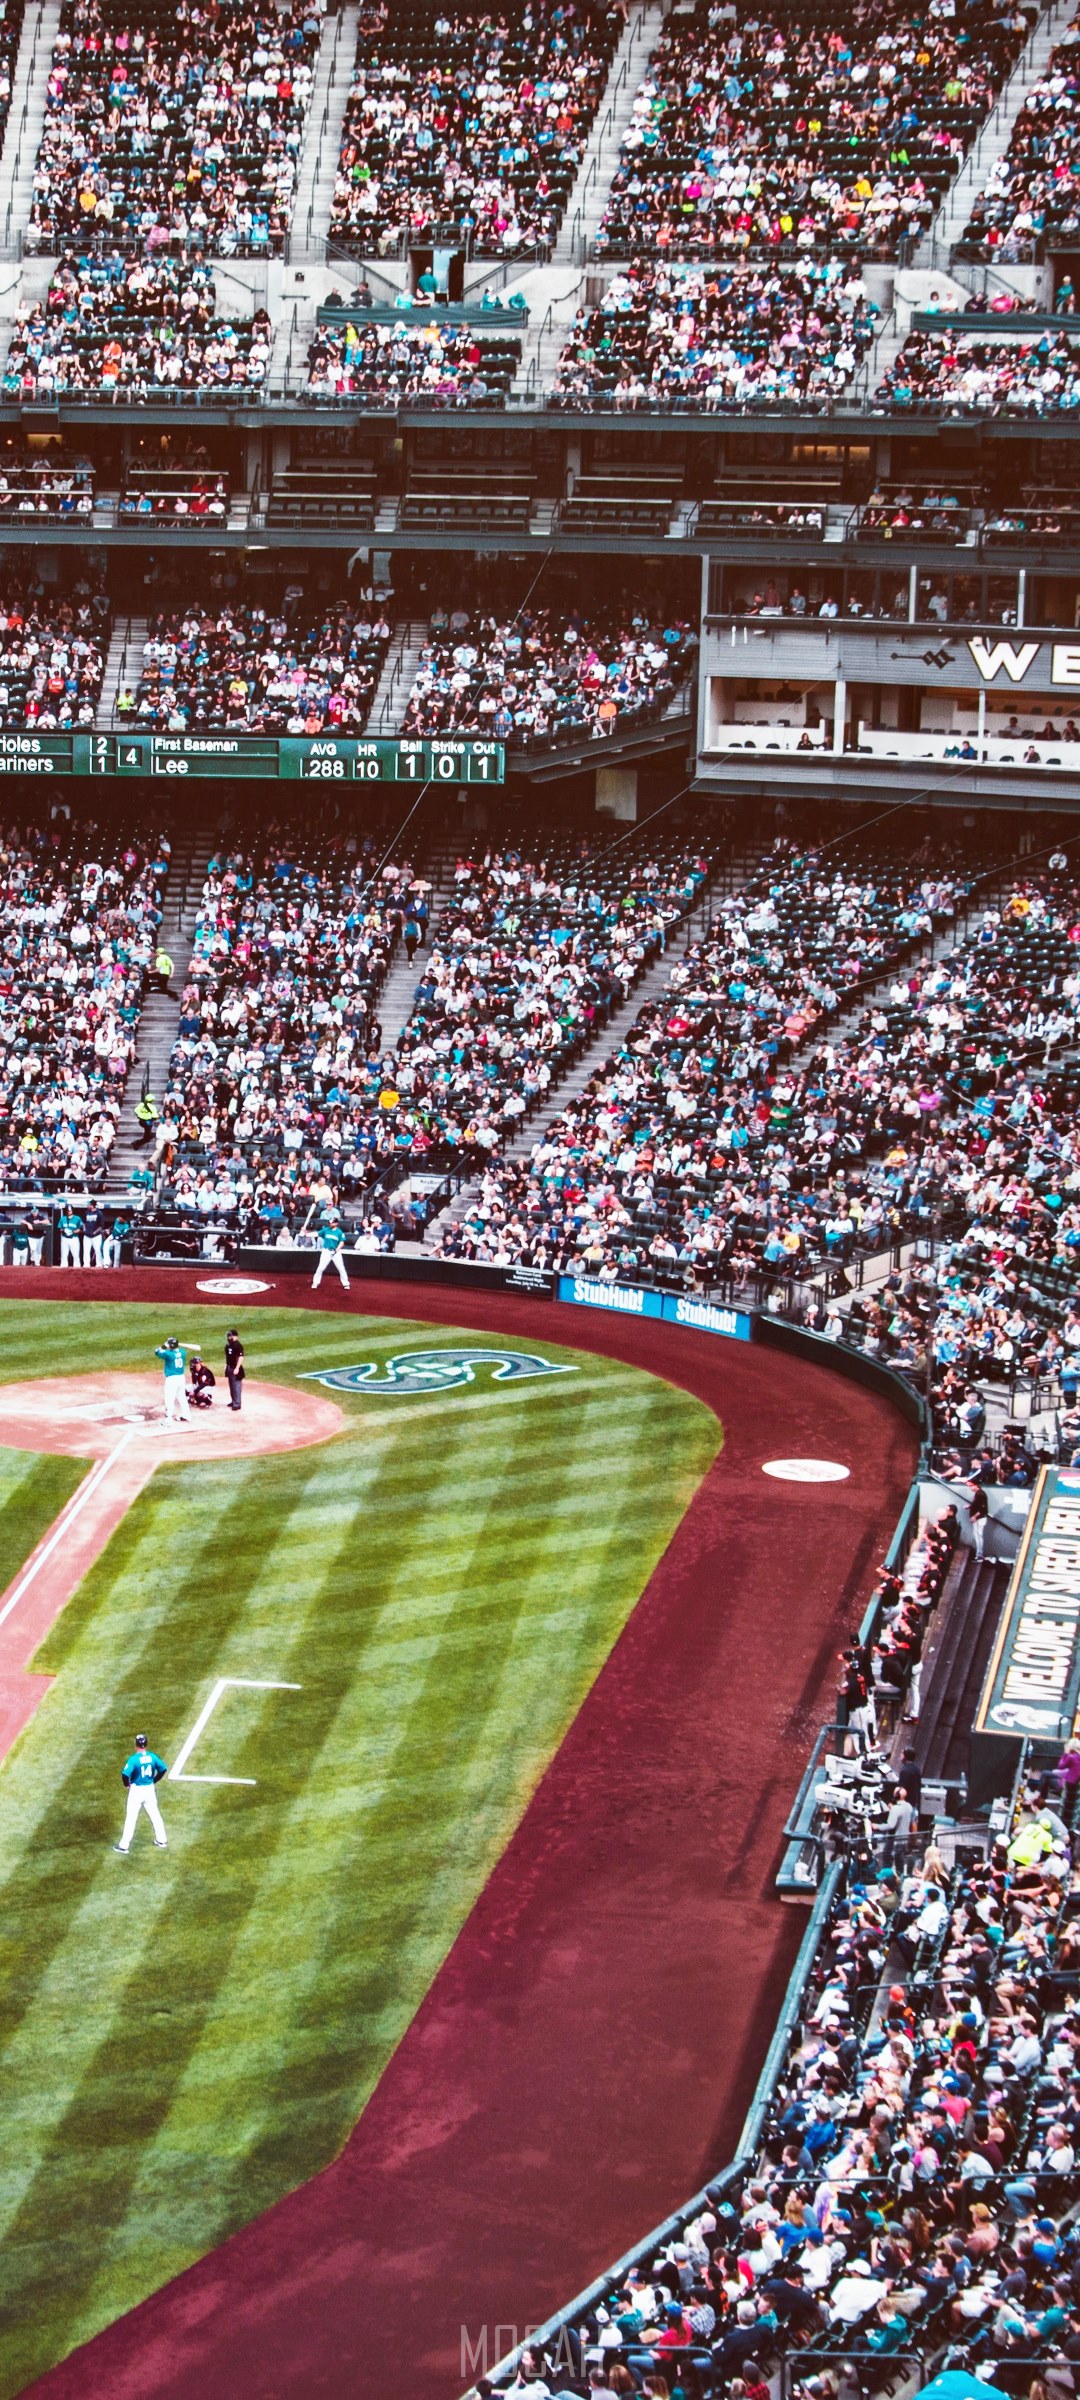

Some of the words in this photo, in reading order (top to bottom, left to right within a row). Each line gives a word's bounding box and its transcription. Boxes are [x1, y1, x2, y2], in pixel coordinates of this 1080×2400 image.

[966, 640, 1080, 684] WE
[97, 737, 108, 754] 2
[154, 737, 181, 751] First
[183, 738, 238, 752] Baseman
[310, 742, 337, 756] AVG
[357, 743, 377, 757] HR
[399, 739, 423, 753] Ball
[431, 740, 466, 754] Strike
[473, 741, 496, 754] Out
[98, 756, 106, 773] 1
[125, 747, 138, 765] 4
[155, 756, 189, 774] Lee
[304, 759, 344, 778] .288
[356, 760, 379, 779] 10
[405, 754, 416, 778] 1
[438, 755, 455, 778] 0
[477, 756, 488, 779] 1
[573, 1279, 644, 1313] StubHub!
[675, 1298, 737, 1335] StubHub!
[1028, 1538, 1080, 1595] SAFECO
[1022, 1592, 1080, 1616] TO
[1001, 1617, 1077, 1701] WELCOME
[140, 1764, 152, 1778] 14
